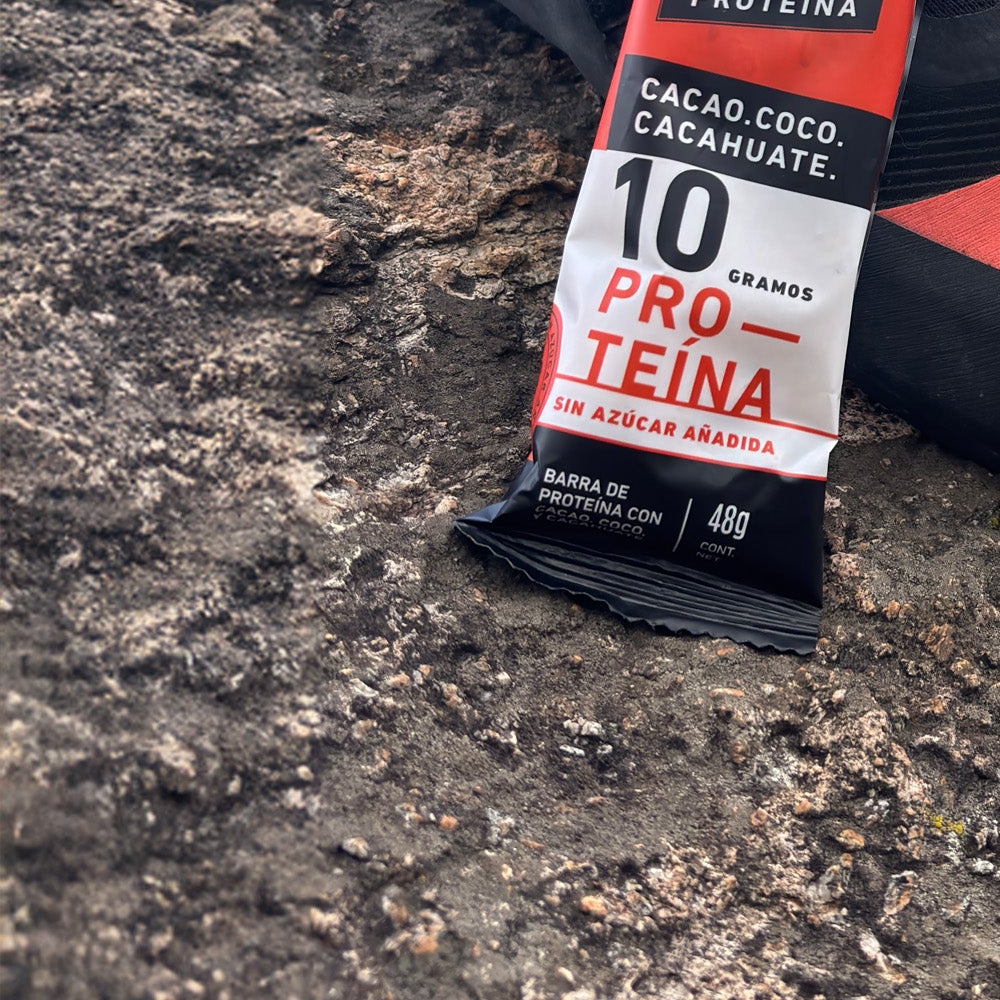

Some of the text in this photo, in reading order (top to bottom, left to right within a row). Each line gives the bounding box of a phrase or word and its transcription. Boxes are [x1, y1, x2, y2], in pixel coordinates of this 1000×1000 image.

[634, 110, 836, 180] CACAHUATE.
[614, 156, 730, 273] 10
[728, 269, 814, 302] GRAMOS
[587, 329, 771, 420] TEÍNA
[553, 396, 585, 417] SIN
[591, 406, 677, 437] AZÚCAR
[682, 424, 775, 455] AÑADIDA
[538, 487, 663, 526] PROTEÍNA CON
[543, 467, 630, 500] BARRA DE
[707, 503, 750, 540] 48g
